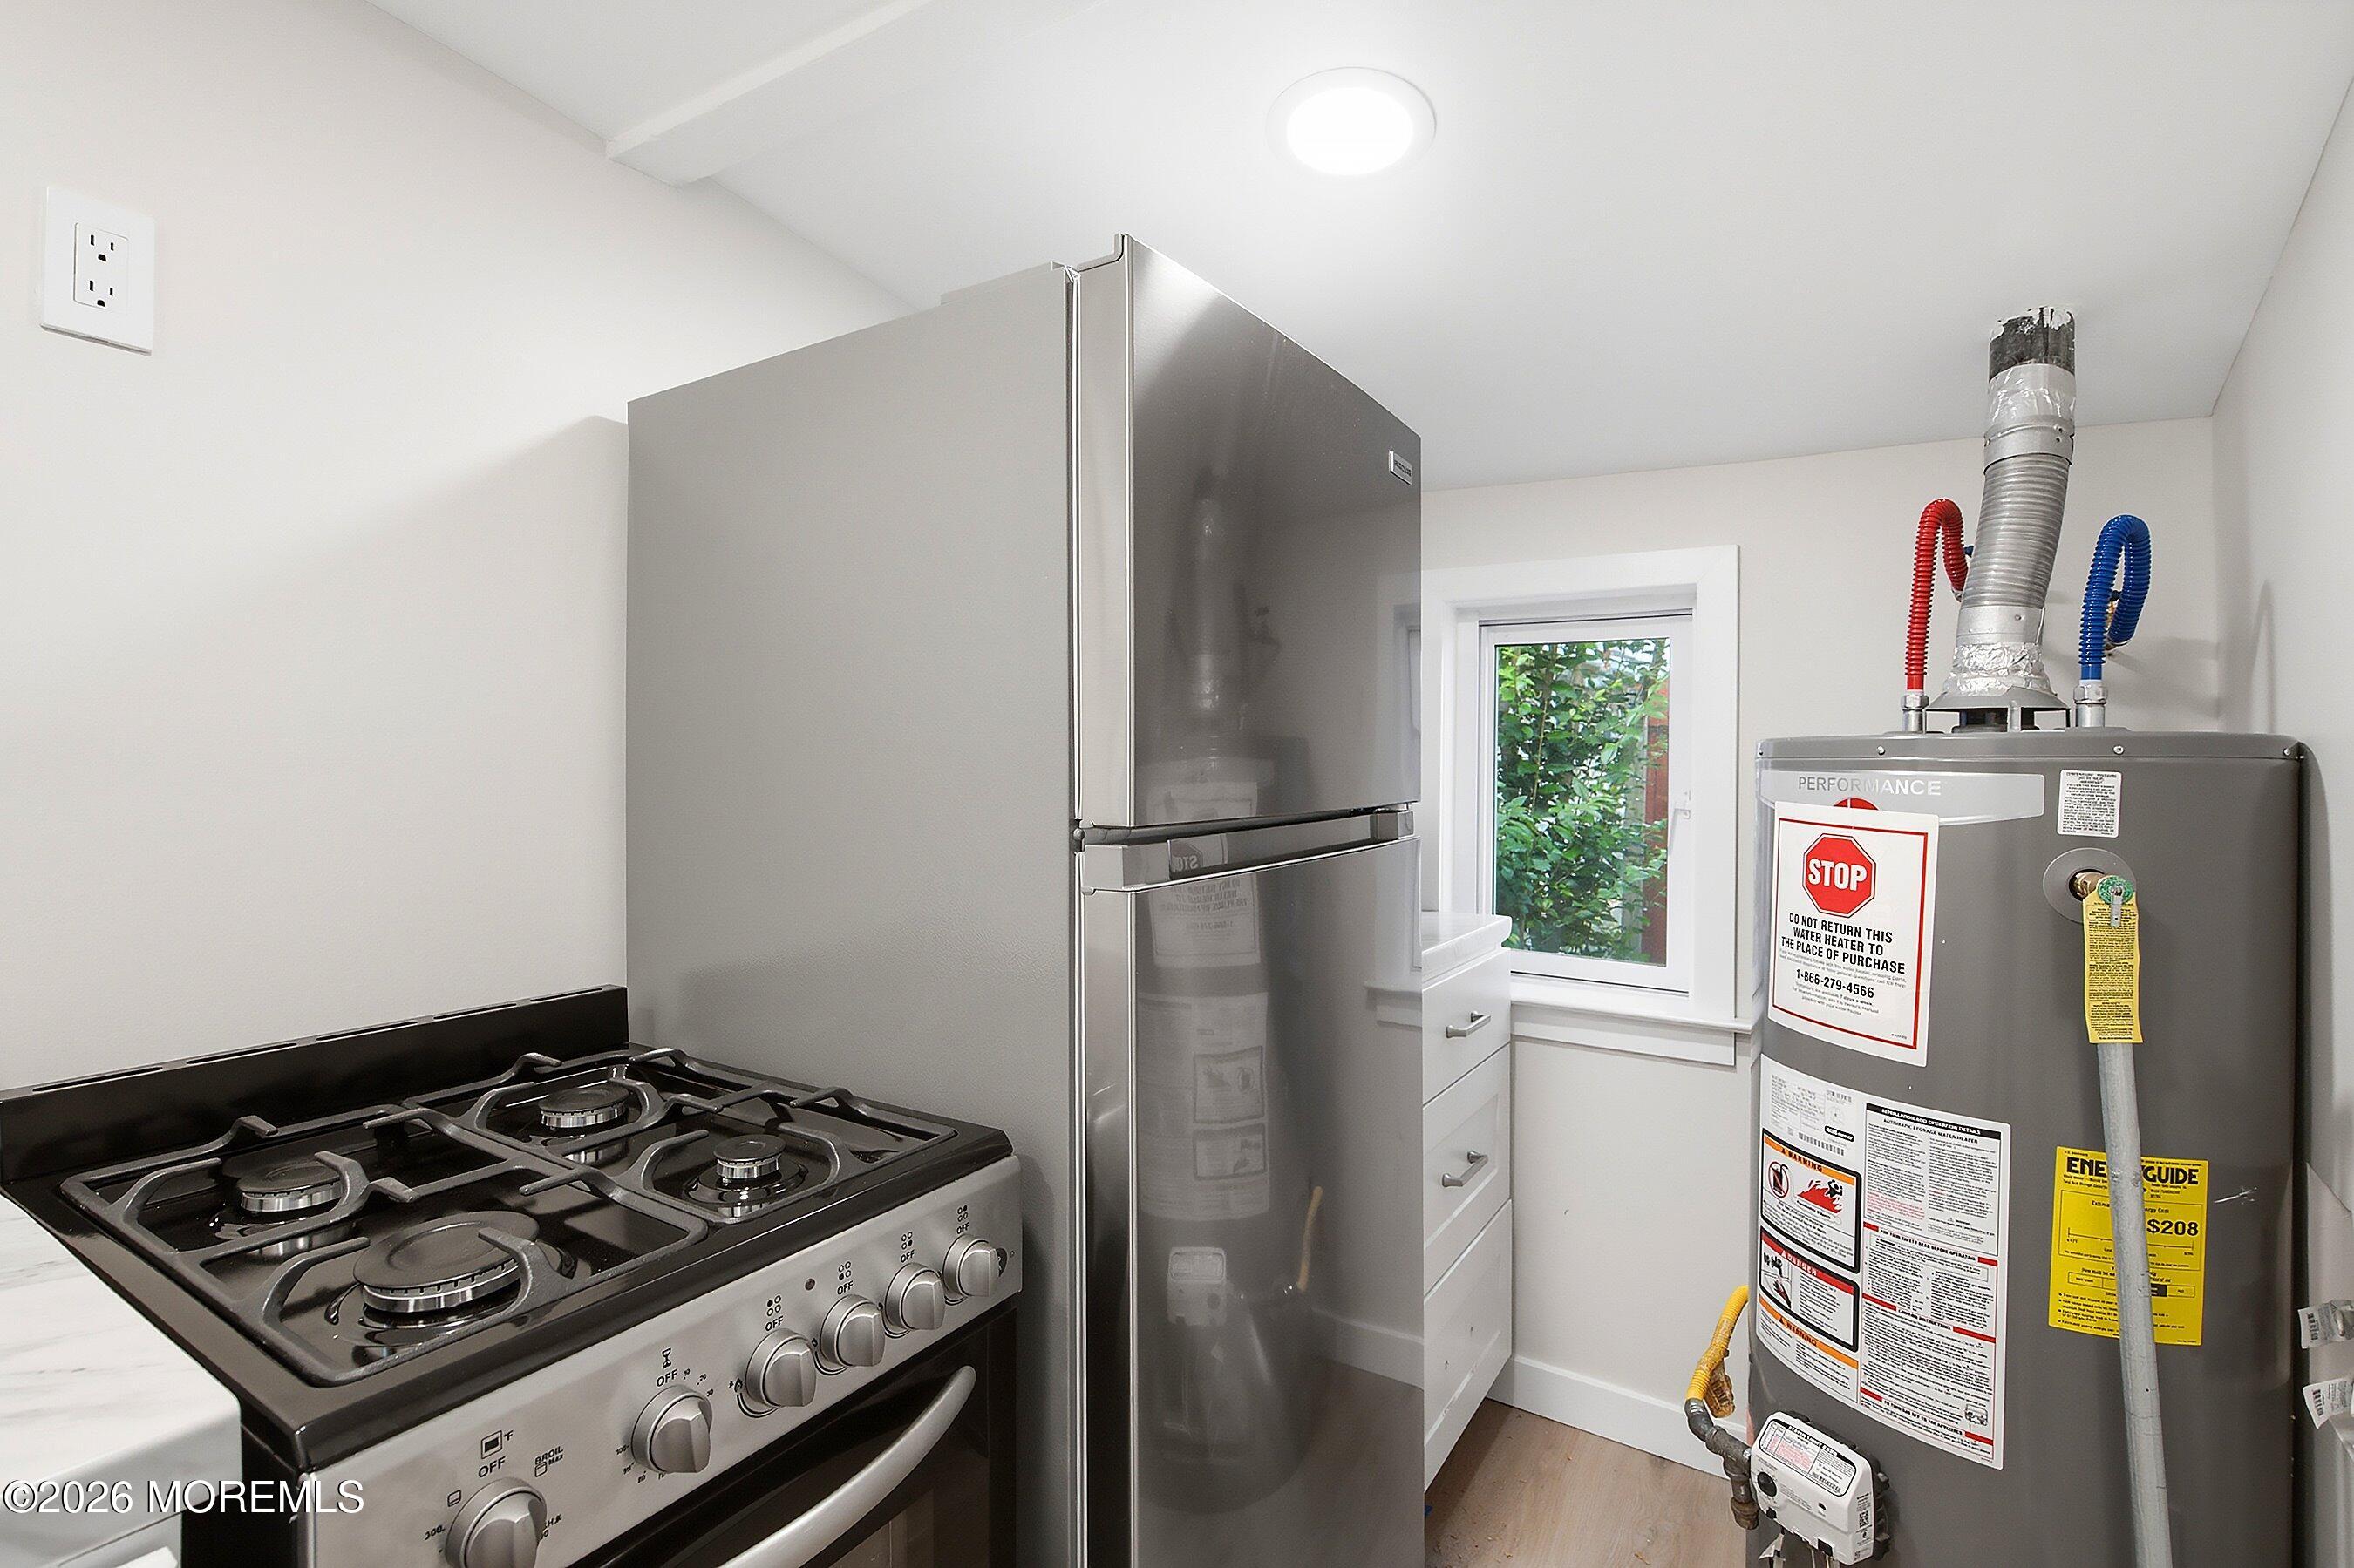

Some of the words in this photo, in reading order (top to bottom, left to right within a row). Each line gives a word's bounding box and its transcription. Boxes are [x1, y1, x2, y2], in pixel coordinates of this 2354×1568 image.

[1798, 776, 1942, 797] PERFORMANCE
[1807, 858, 1868, 892] STOP
[1789, 912, 1800, 925] DO
[1801, 915, 1819, 929] NOT
[1820, 920, 1861, 938] RETURN
[1866, 927, 1893, 944] THIS
[1793, 927, 1822, 944] WATER
[1824, 934, 1864, 953] HEATER
[1868, 942, 1884, 956] TO
[1781, 936, 1794, 950] THE
[1796, 940, 1824, 958] PLACE
[1826, 948, 1840, 960] OF
[1842, 952, 1906, 974] PURCHASE
[1796, 968, 1875, 999] 1-866-279-4566
[956, 1222, 969, 1235] OFF
[2146, 1218, 2199, 1237] $208
[900, 1249, 915, 1263] OFF
[837, 1280, 854, 1295] OFF
[765, 1315, 784, 1333] OFF
[656, 1368, 679, 1388] OFF
[534, 1445, 564, 1466] BROIL
[478, 1456, 507, 1478] OFF
